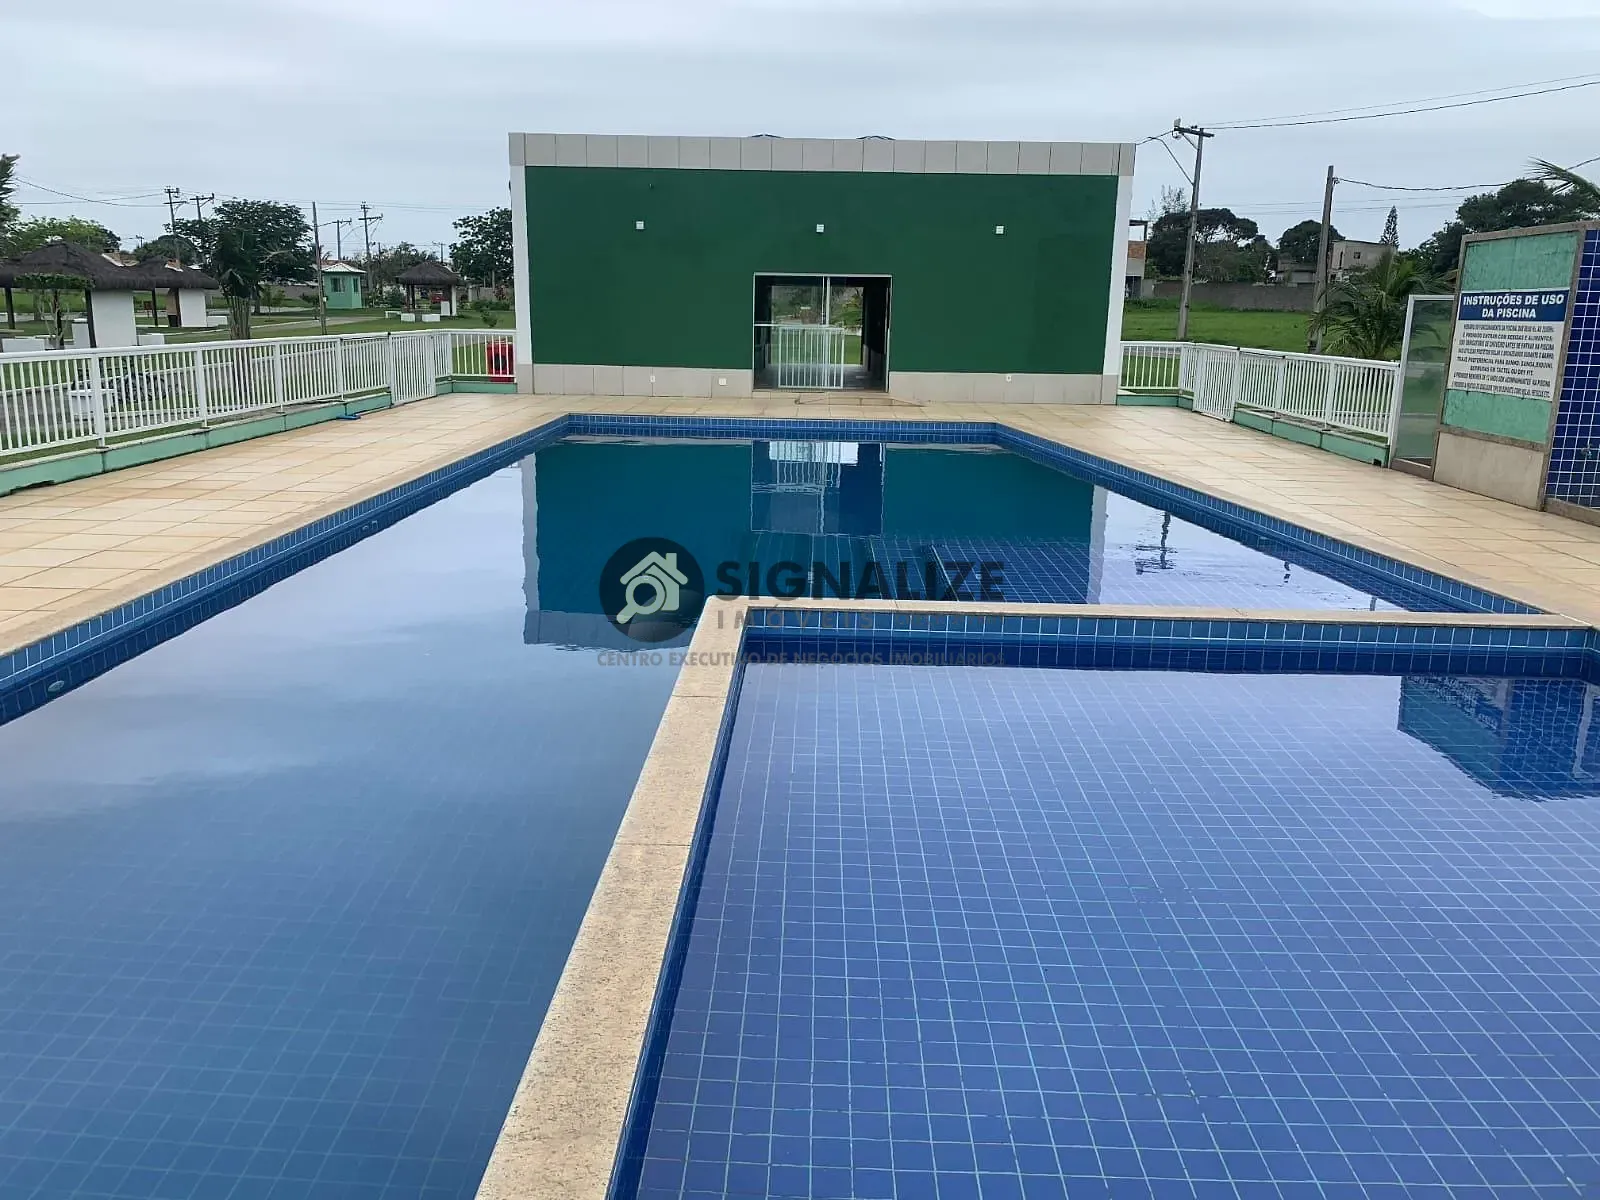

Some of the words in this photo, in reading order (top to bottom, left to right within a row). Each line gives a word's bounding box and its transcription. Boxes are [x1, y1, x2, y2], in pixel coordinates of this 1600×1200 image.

[1463, 294, 1522, 307] INSTRUÇÕES
[1525, 295, 1539, 305] DE
[1541, 294, 1565, 305] USO
[1482, 308, 1494, 318] DA
[1496, 308, 1537, 318] PISCINA
